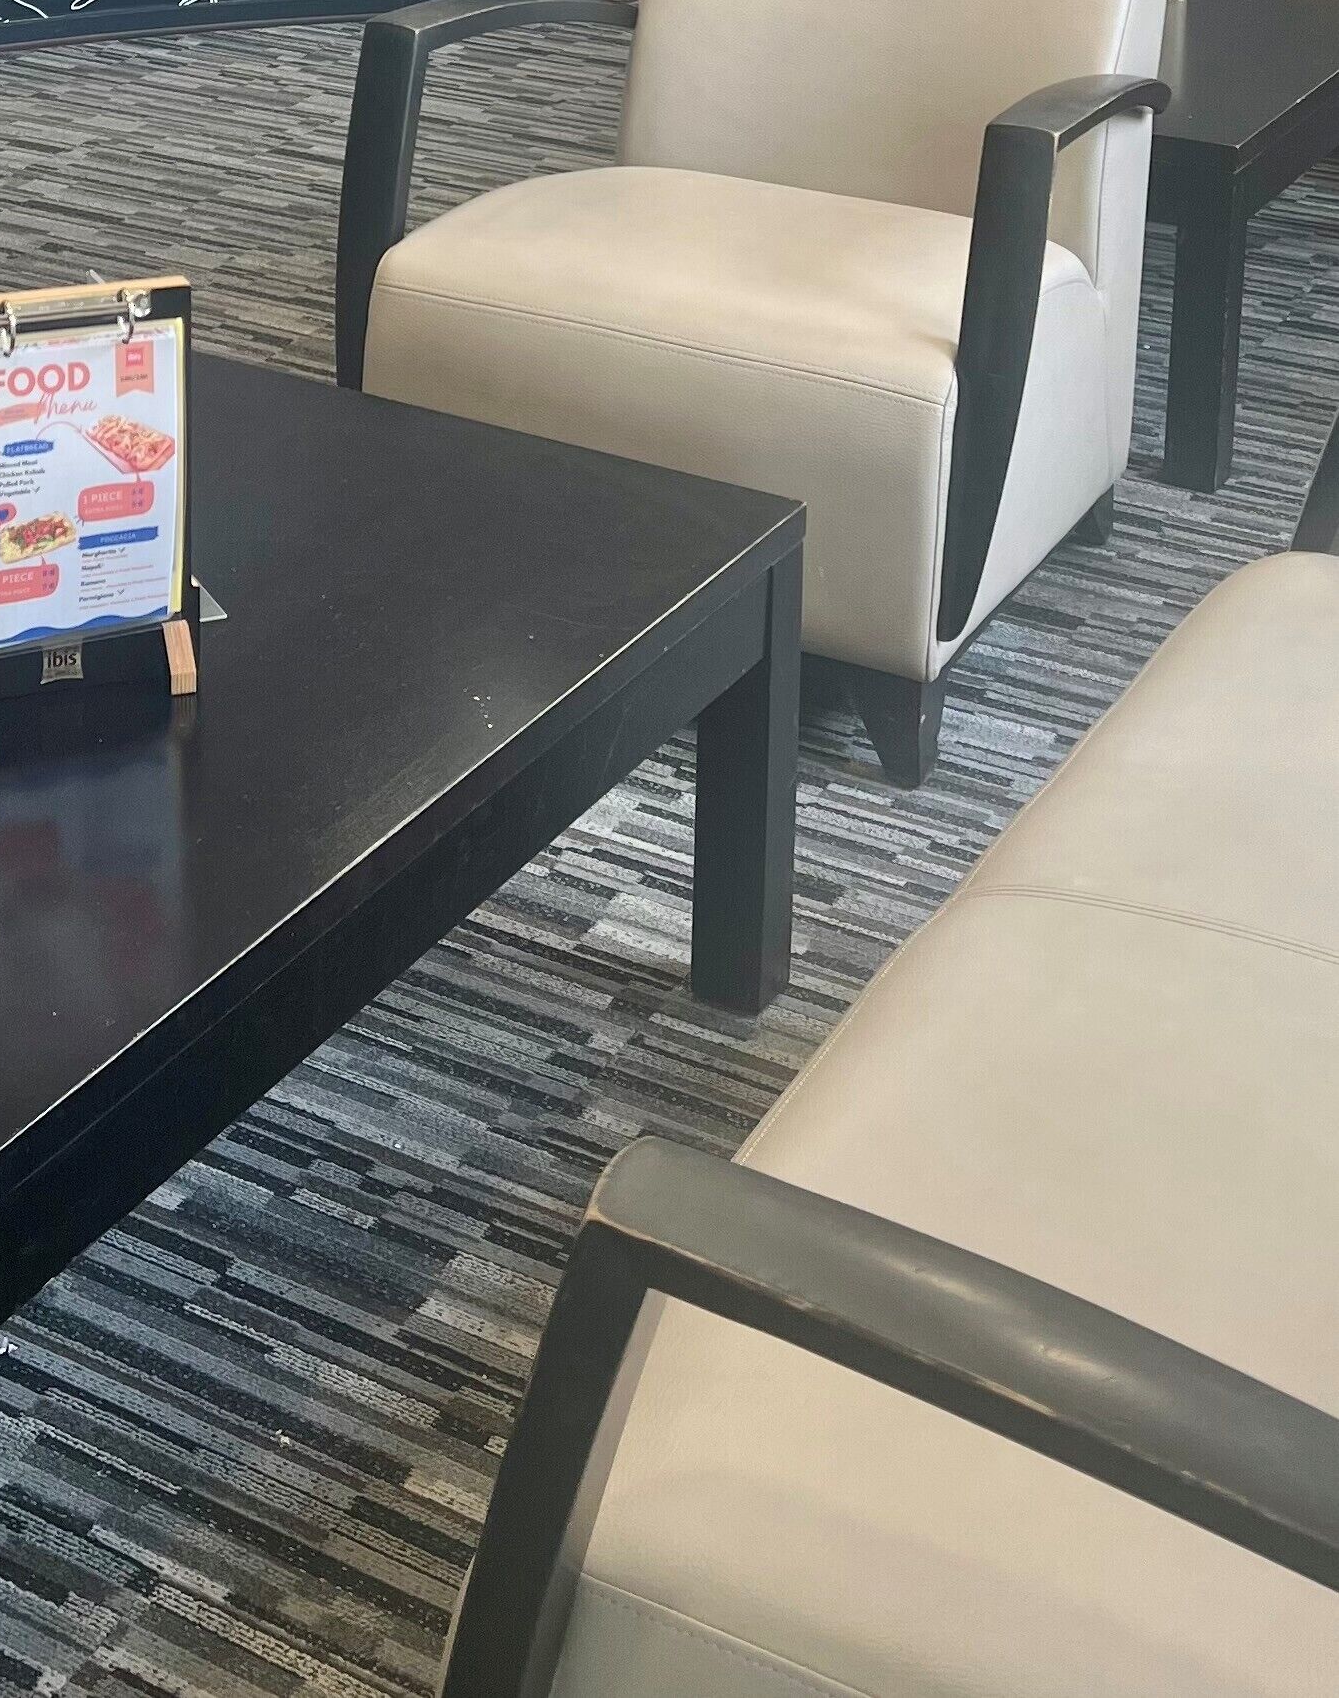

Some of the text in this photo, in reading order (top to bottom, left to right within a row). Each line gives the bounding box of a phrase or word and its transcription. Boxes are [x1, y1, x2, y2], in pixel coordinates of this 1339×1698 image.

[91, 490, 121, 503] PIECE
[2, 573, 33, 584] PIECE
[47, 649, 77, 668] ibis
